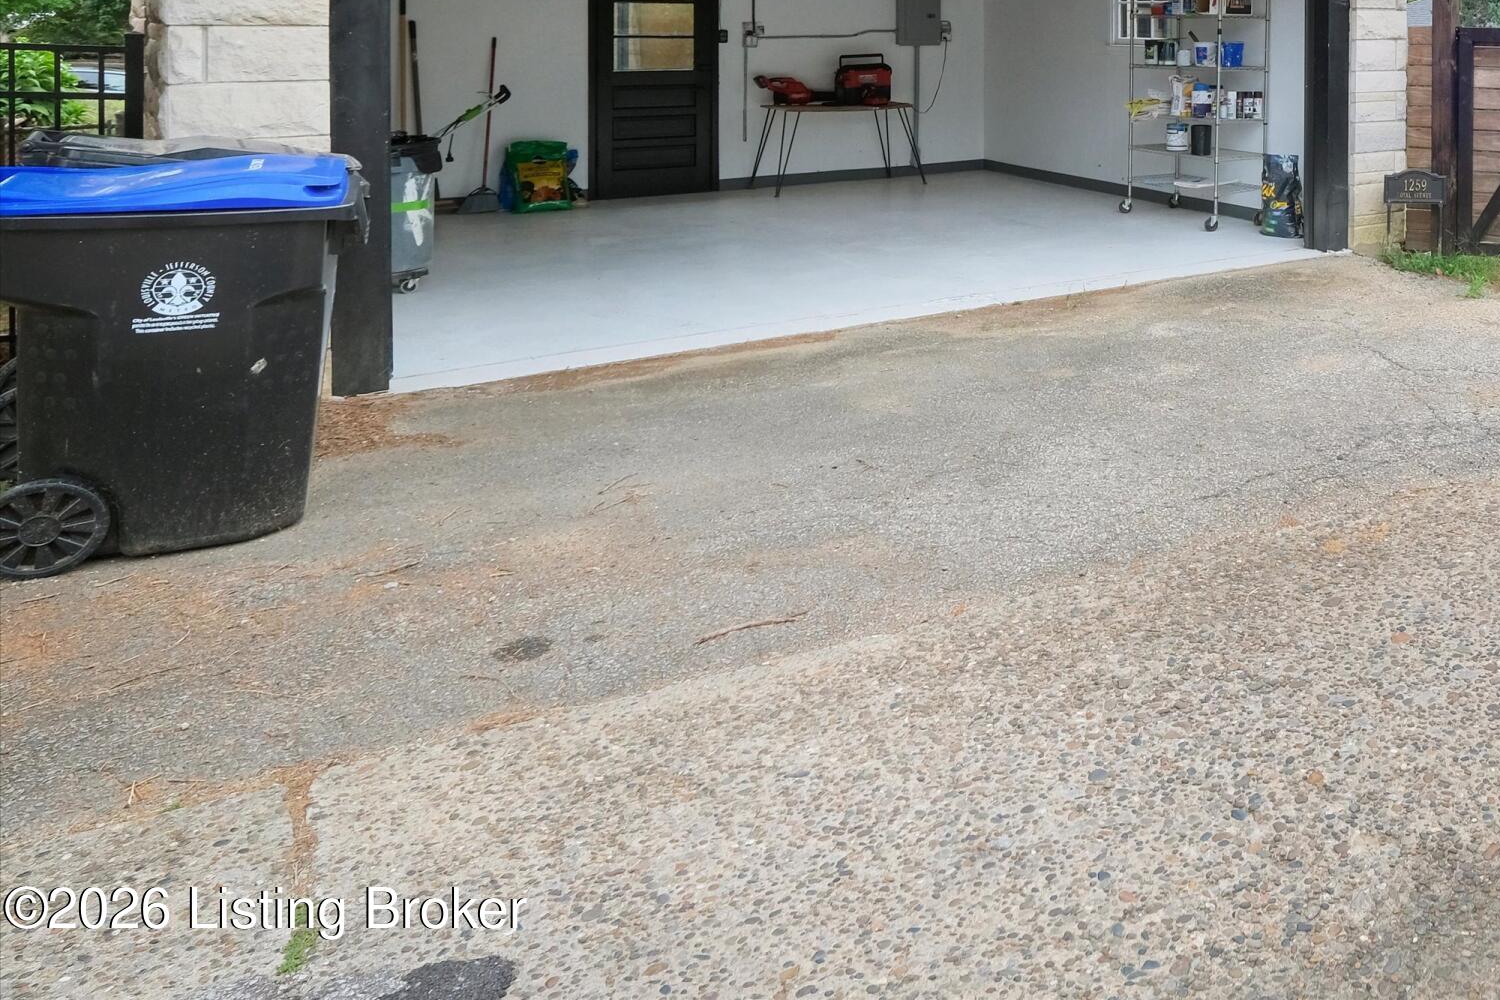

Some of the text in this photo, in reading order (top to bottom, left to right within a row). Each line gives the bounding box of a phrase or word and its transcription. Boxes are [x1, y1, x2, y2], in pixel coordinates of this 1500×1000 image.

[1404, 179, 1427, 191] 1259
[140, 271, 159, 307] LOUISVILLE
[165, 261, 211, 277] JEFFERSON
[201, 276, 216, 303] COUNTY
